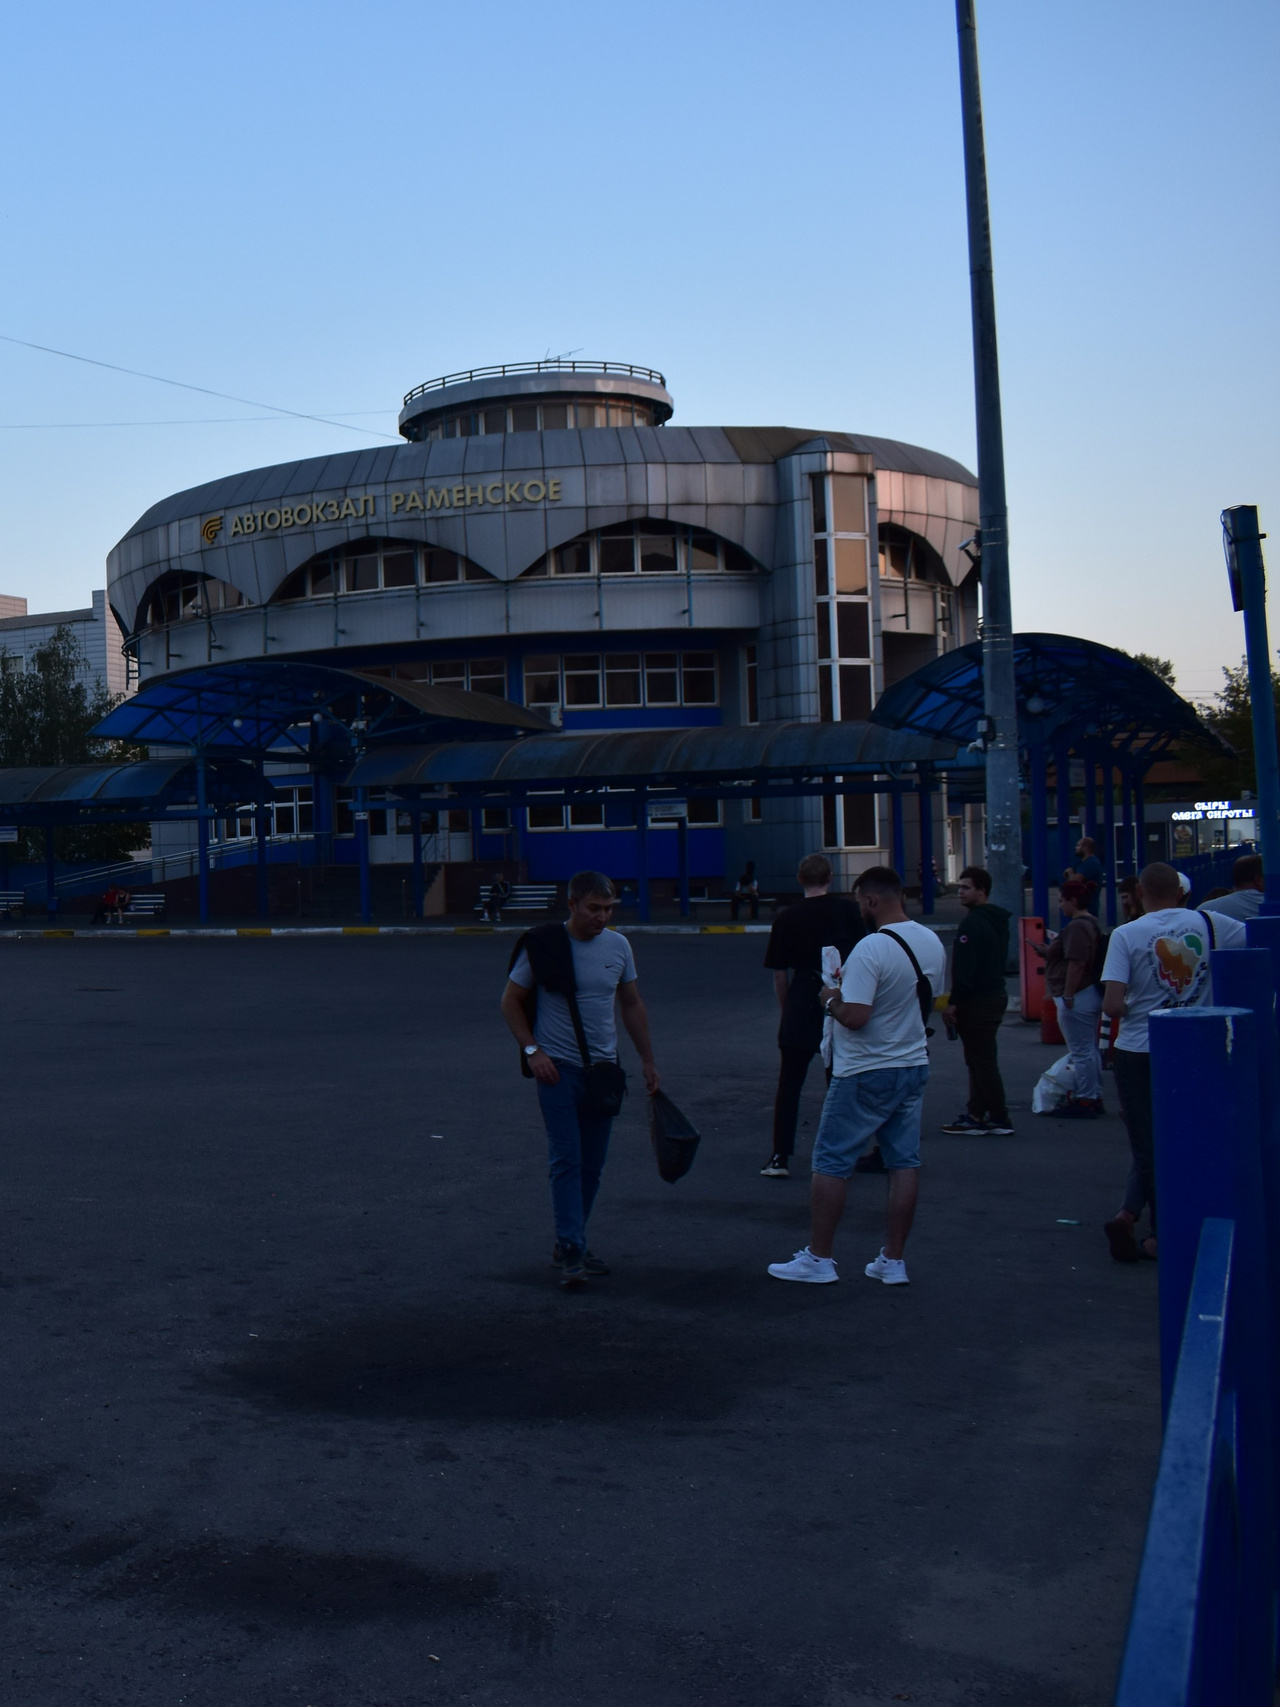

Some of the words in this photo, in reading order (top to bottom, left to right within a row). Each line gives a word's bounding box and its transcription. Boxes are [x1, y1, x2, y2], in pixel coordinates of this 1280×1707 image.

[231, 494, 375, 537] АВТОВОКЗАЛ
[390, 479, 562, 513] РАМЕНСКОЕ
[1194, 801, 1230, 811] СЫРЫ
[1206, 808, 1254, 819] СИРОТЫ
